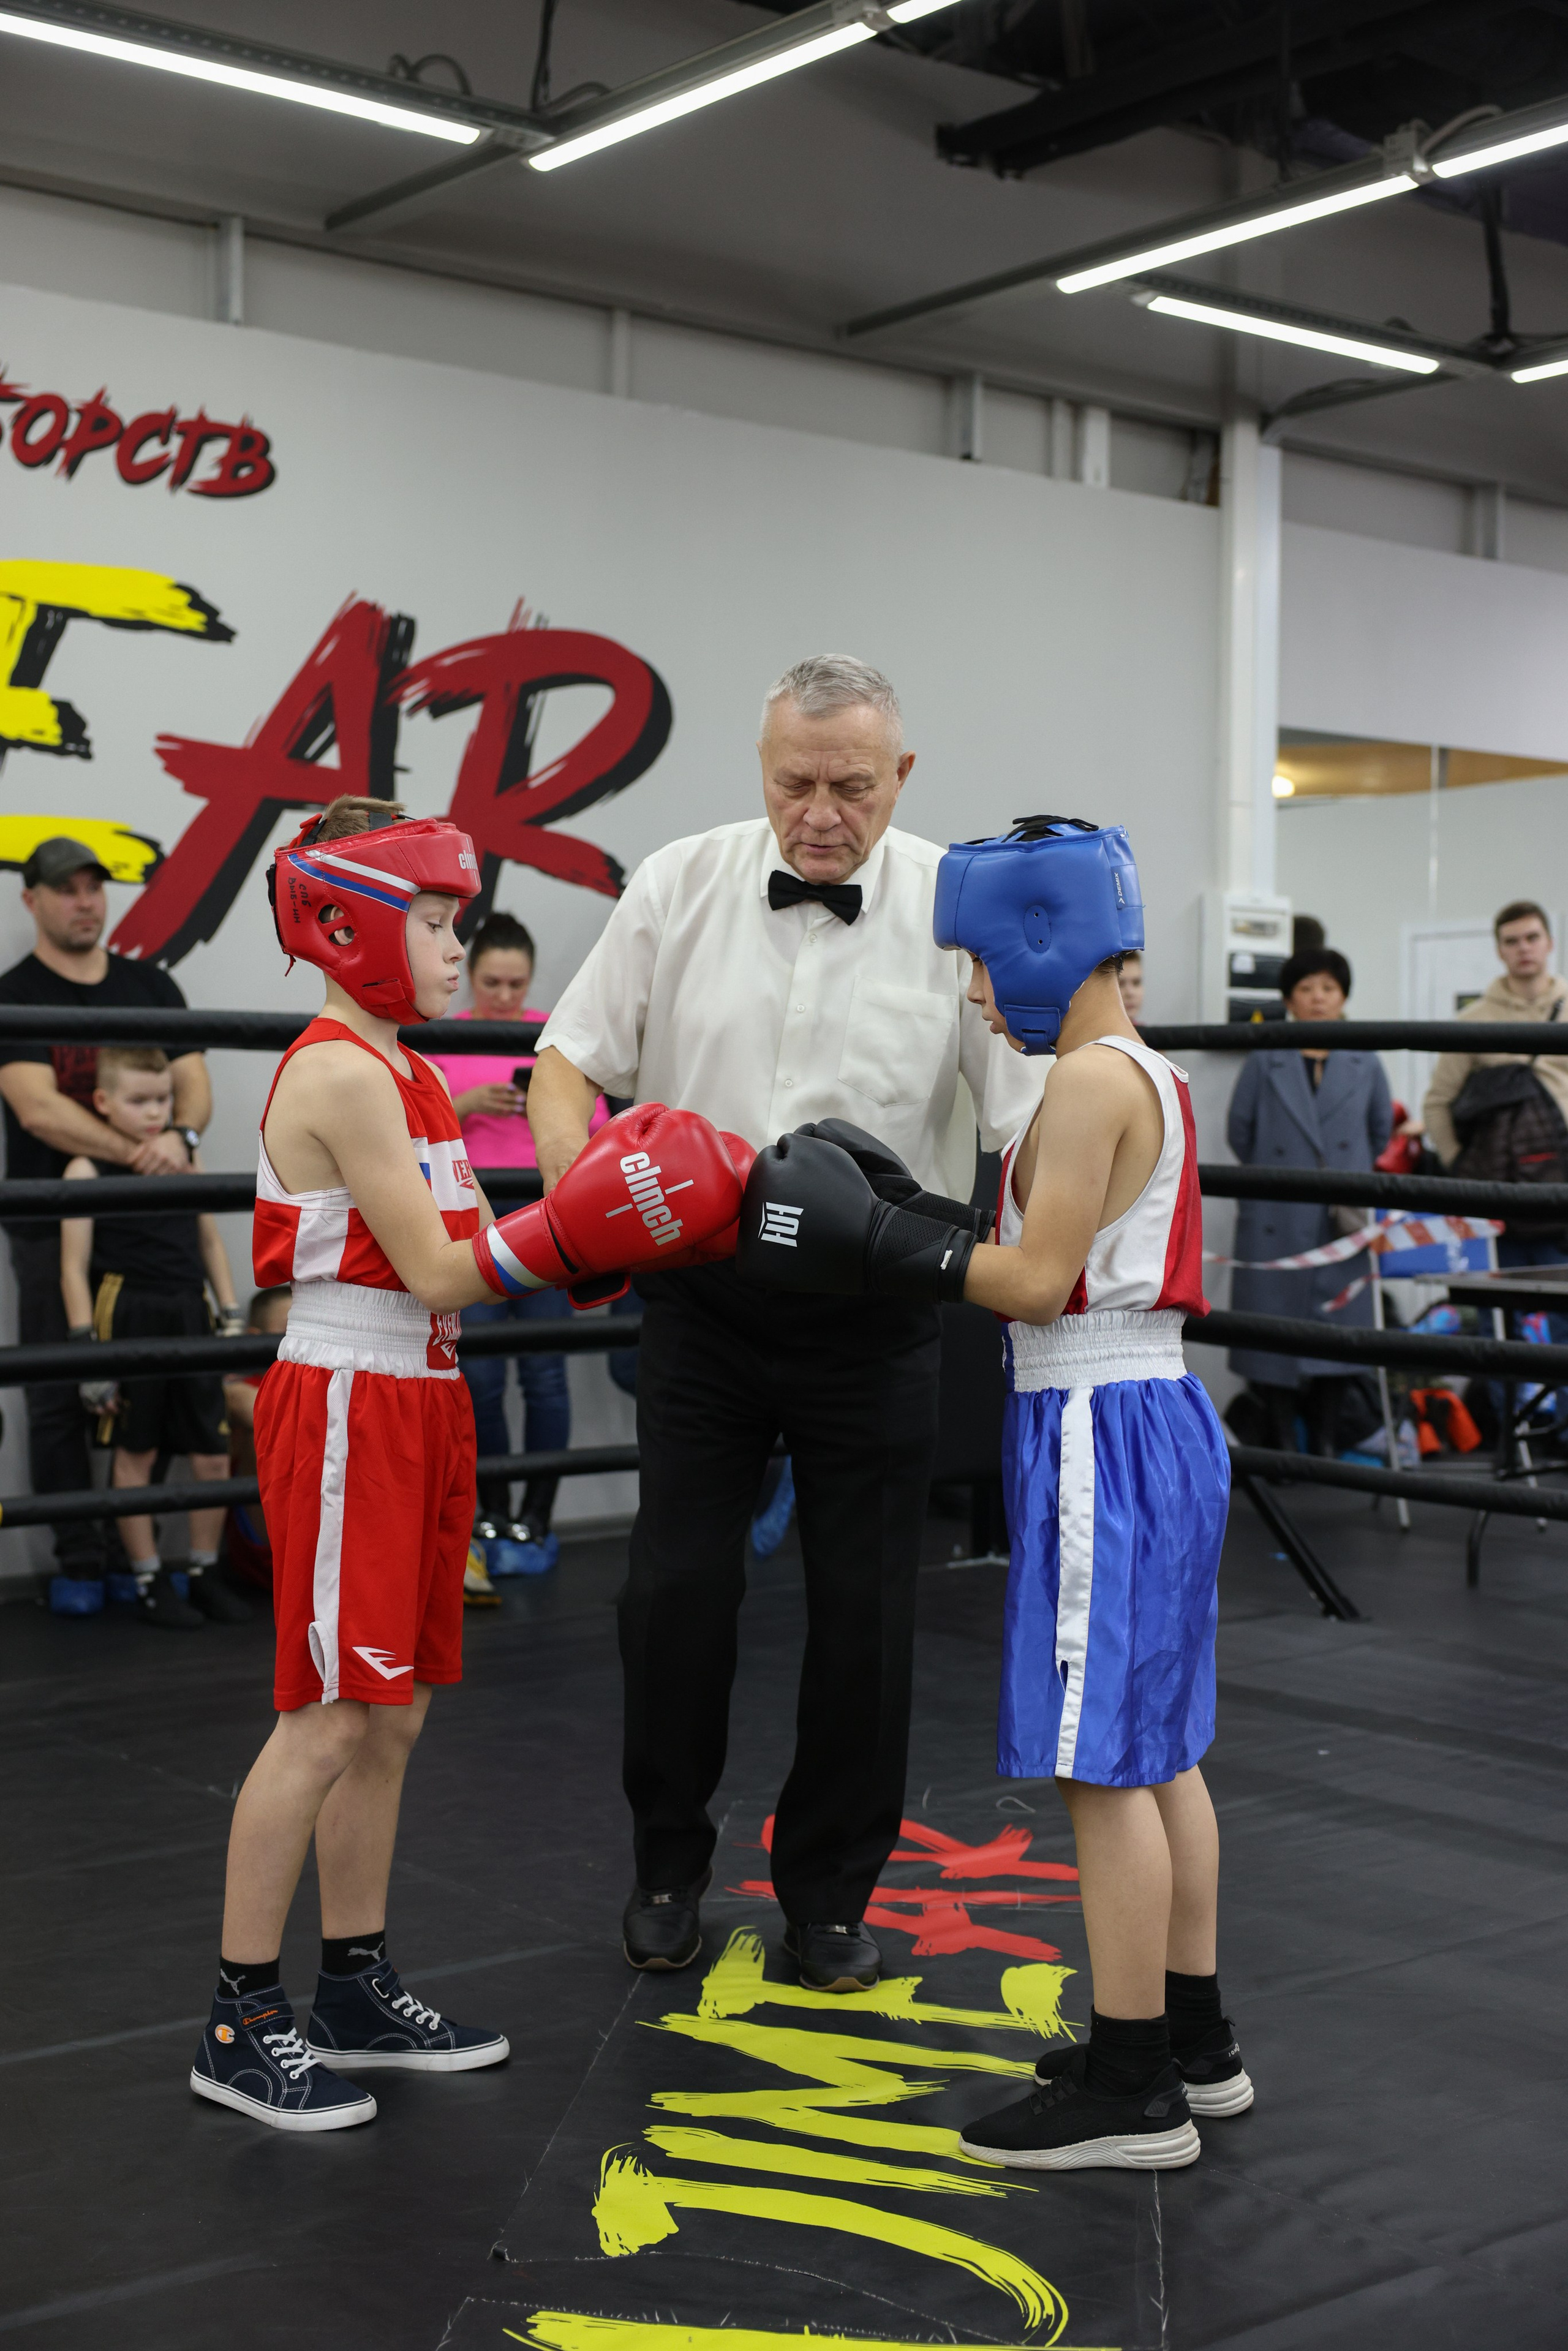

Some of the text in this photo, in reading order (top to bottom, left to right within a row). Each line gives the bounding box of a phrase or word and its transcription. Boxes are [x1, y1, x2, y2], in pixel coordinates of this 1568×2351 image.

[0, 361, 275, 498] ОРСТВ
[1114, 872, 1123, 897] DEMIX
[620, 1152, 684, 1247] clinch
